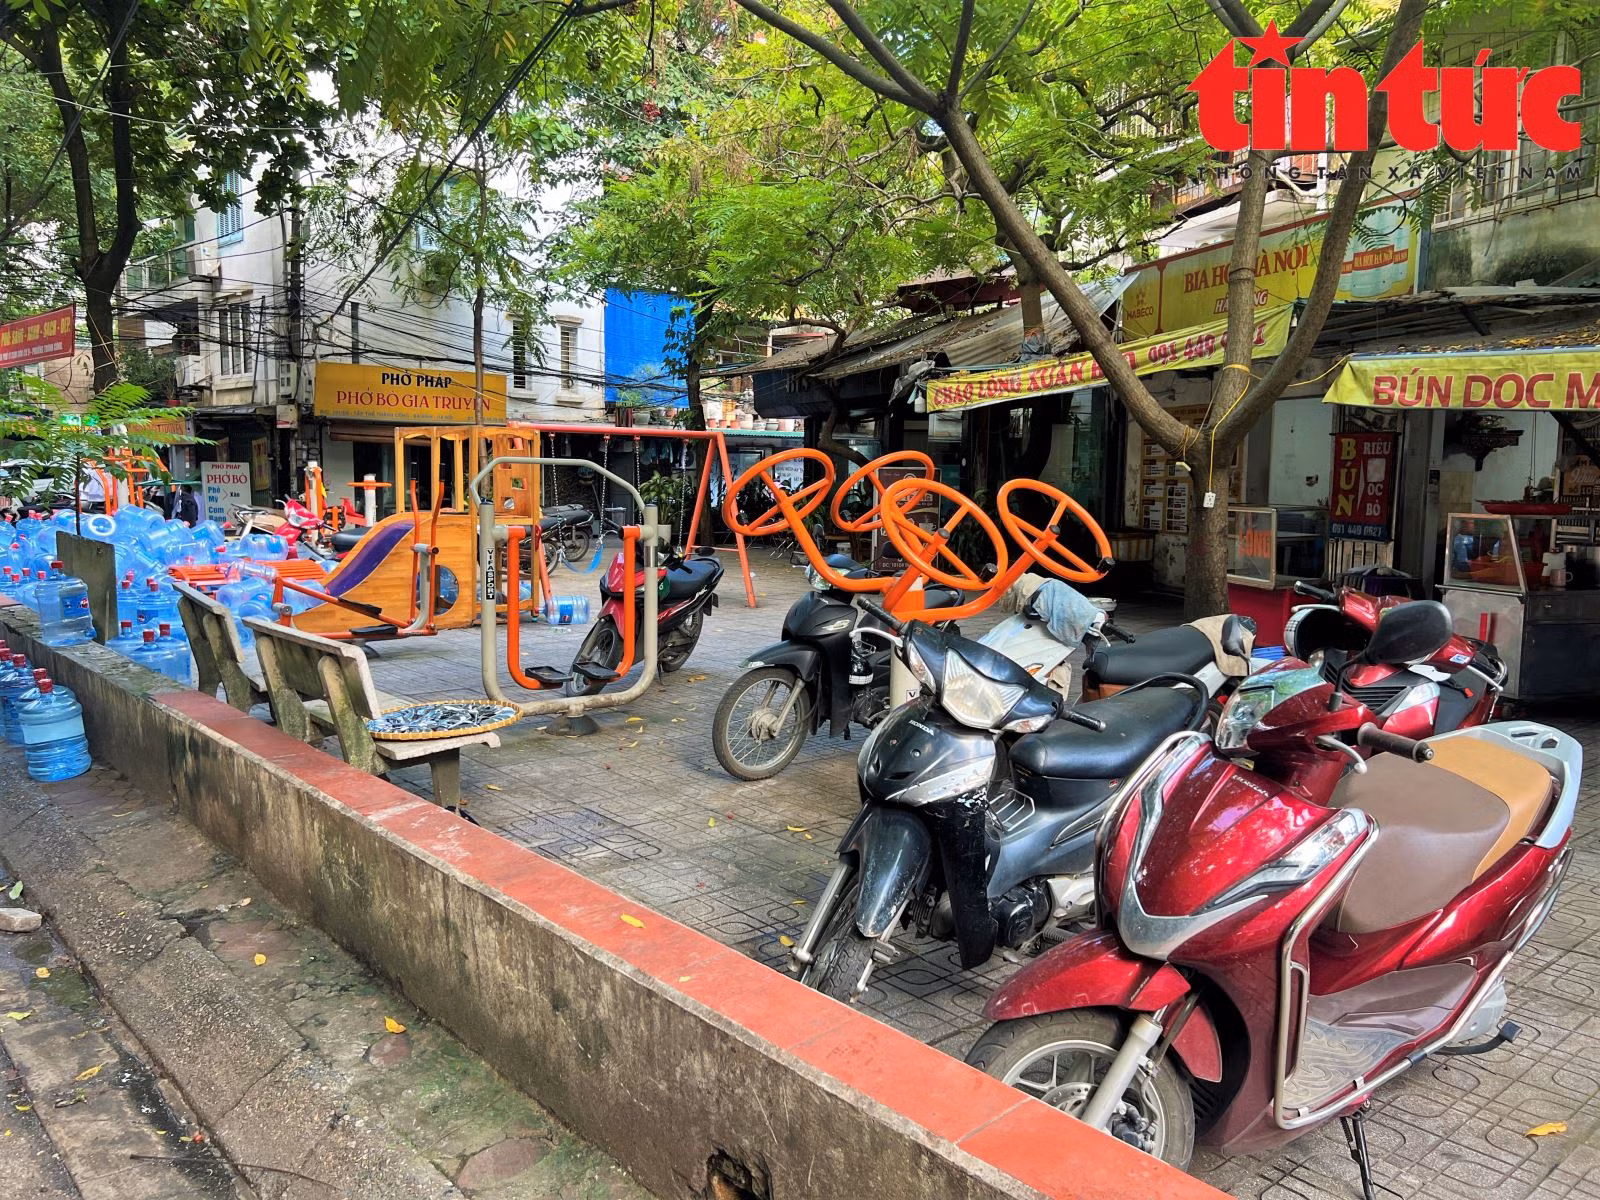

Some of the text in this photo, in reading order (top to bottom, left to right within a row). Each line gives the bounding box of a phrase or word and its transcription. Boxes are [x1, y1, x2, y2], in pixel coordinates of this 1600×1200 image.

[1184, 268, 1210, 293] BIA
[1273, 245, 1309, 276] NỘI
[1127, 307, 1154, 320] HABECO
[381, 370, 452, 388] PHỞ PHÁP
[1373, 367, 1454, 408] BÚN
[336, 387, 374, 406] PHỞ
[376, 391, 400, 407] BÒ
[402, 394, 429, 409] GIA
[1363, 438, 1391, 455] RIÊU
[207, 471, 231, 484] PHỞ
[1335, 438, 1358, 517] BÚN
[909, 719, 934, 736] HONDA
